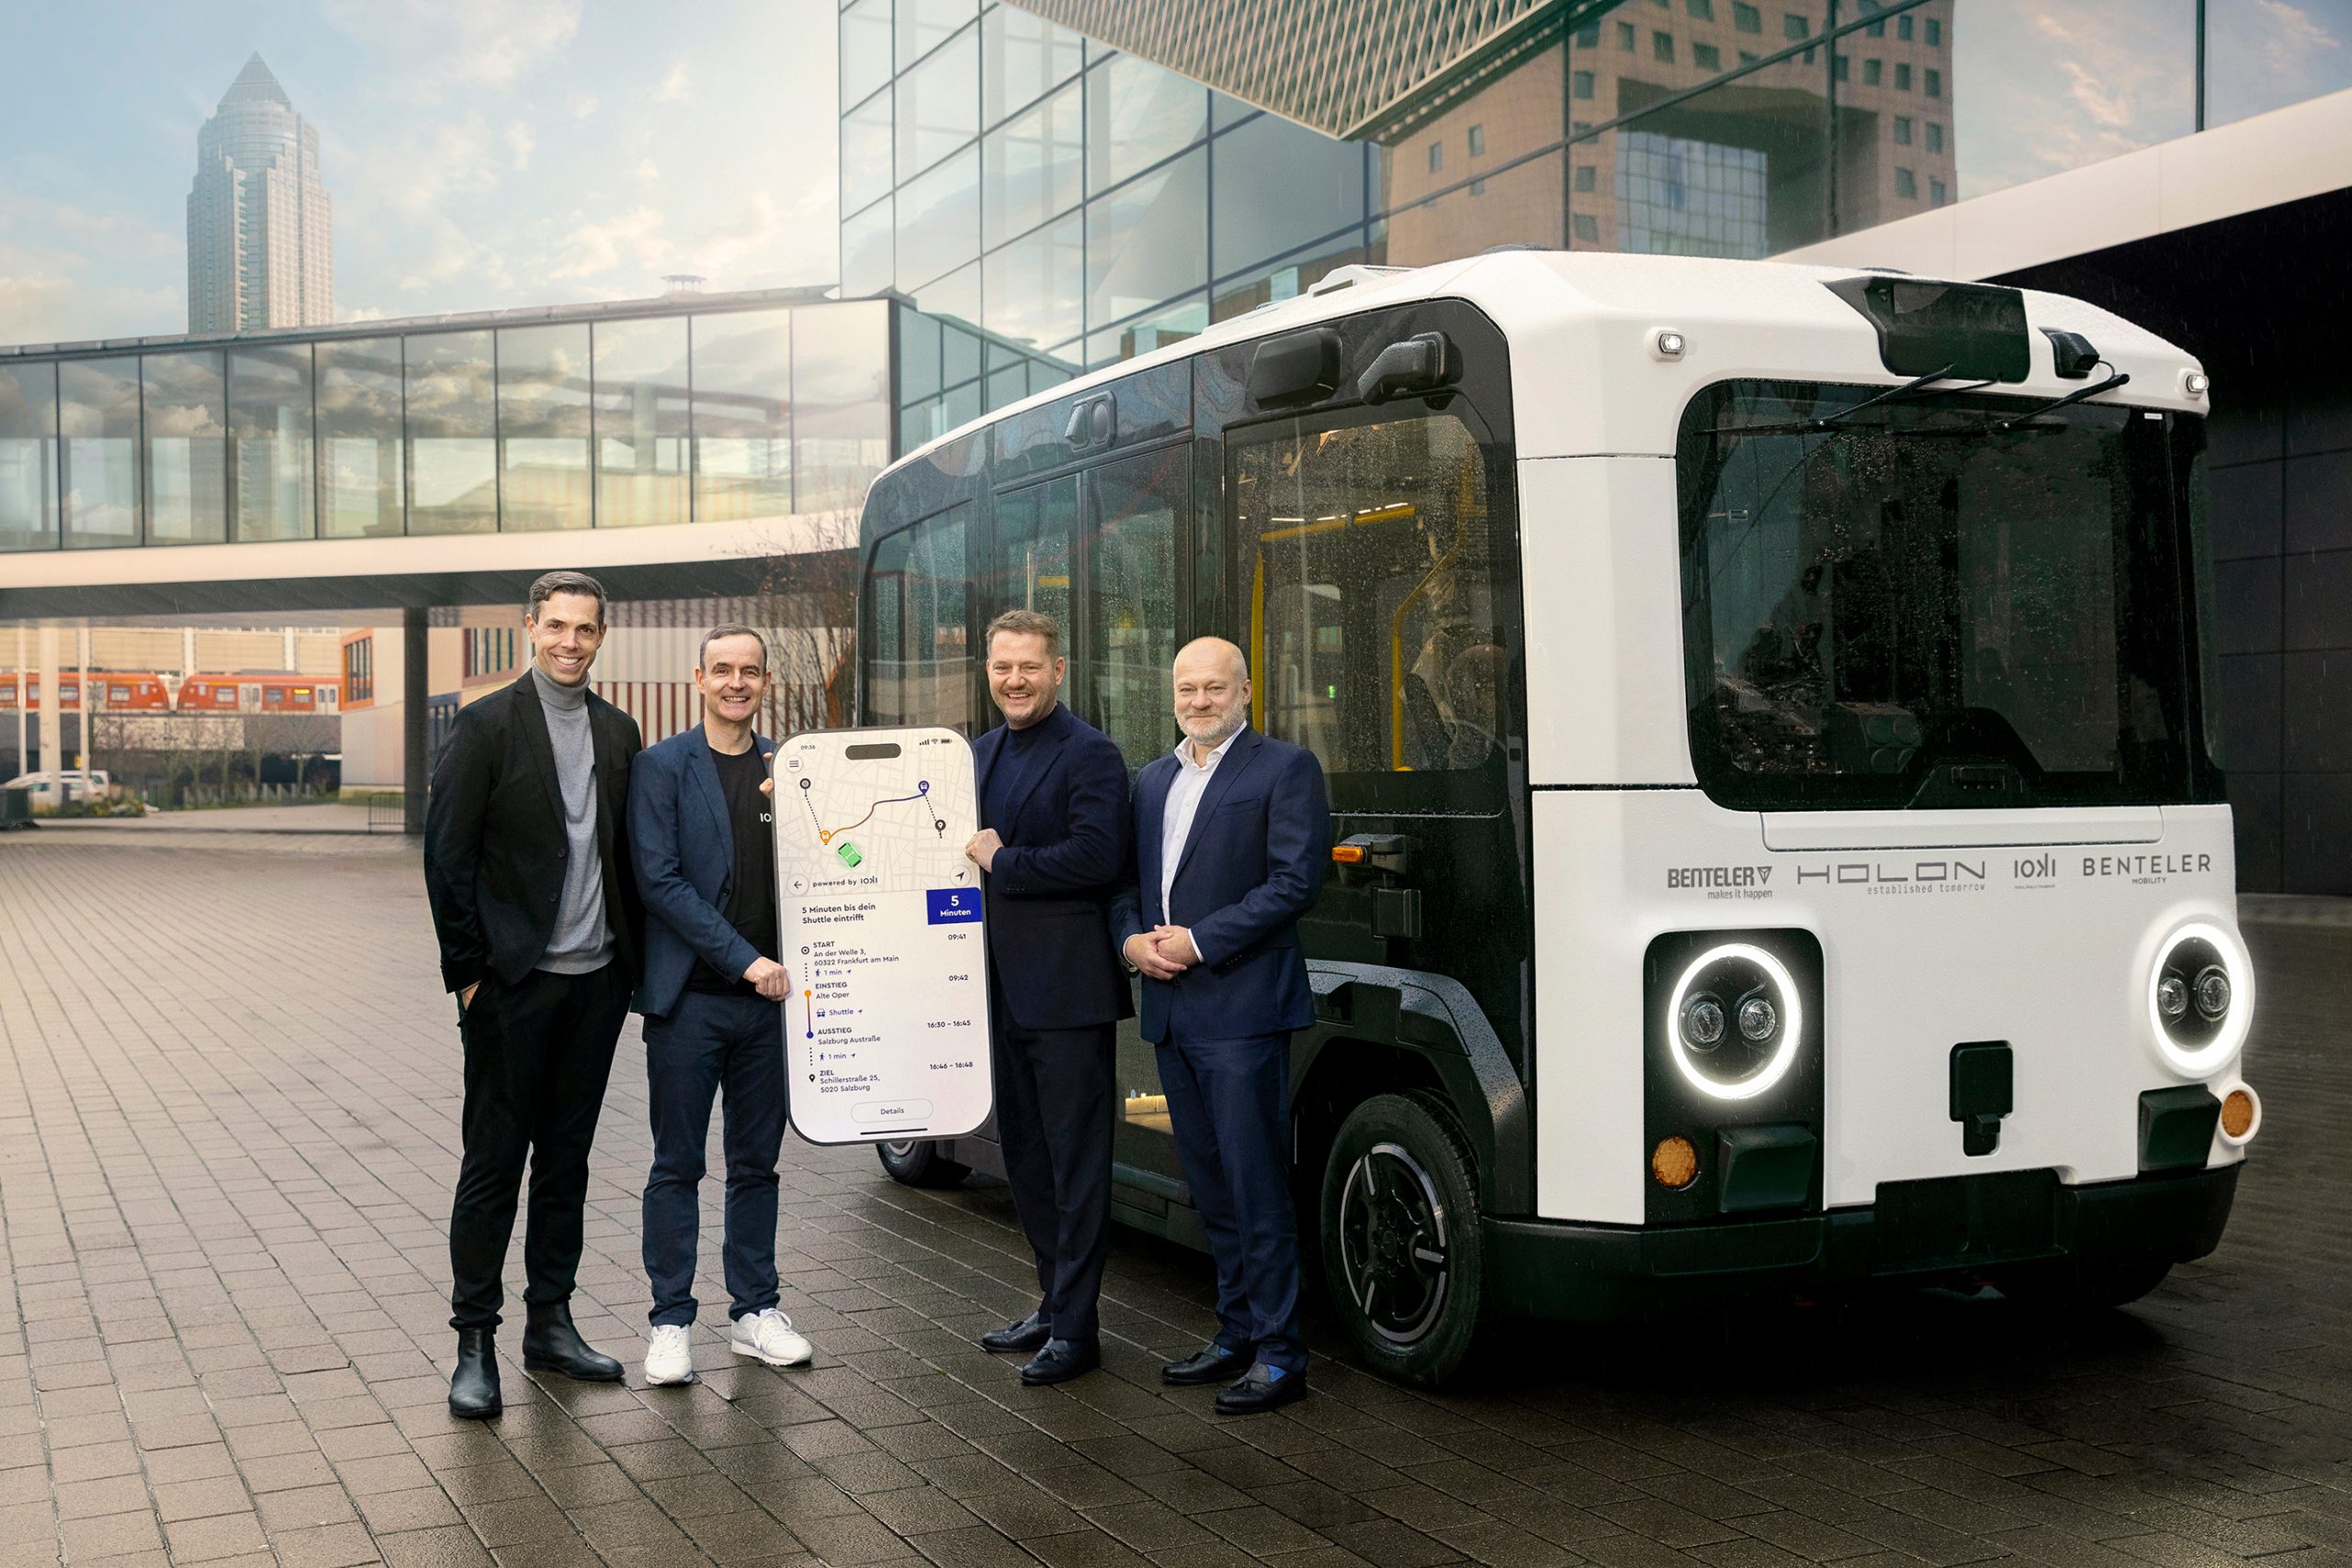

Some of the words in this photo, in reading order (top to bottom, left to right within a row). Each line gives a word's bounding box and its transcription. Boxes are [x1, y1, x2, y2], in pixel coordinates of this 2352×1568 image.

[2083, 853, 2211, 876] BENTELER
[1668, 866, 1755, 888] BENTELER
[1797, 861, 1985, 885] HOLON
[812, 878, 845, 887] powered
[847, 877, 857, 886] by
[2132, 876, 2166, 885] MOBILITY
[1707, 890, 1733, 899] makes
[1735, 888, 1741, 898] it
[1744, 888, 1772, 900] happen
[1867, 884, 1933, 895] established
[1939, 883, 1985, 893] tomorrow
[950, 895, 959, 907] 5
[940, 908, 971, 917] Minuten
[802, 916, 831, 924] Shuttle
[833, 914, 865, 922] eintrifft
[818, 1027, 852, 1035] AUSSTIEG
[880, 1107, 905, 1115] Details
